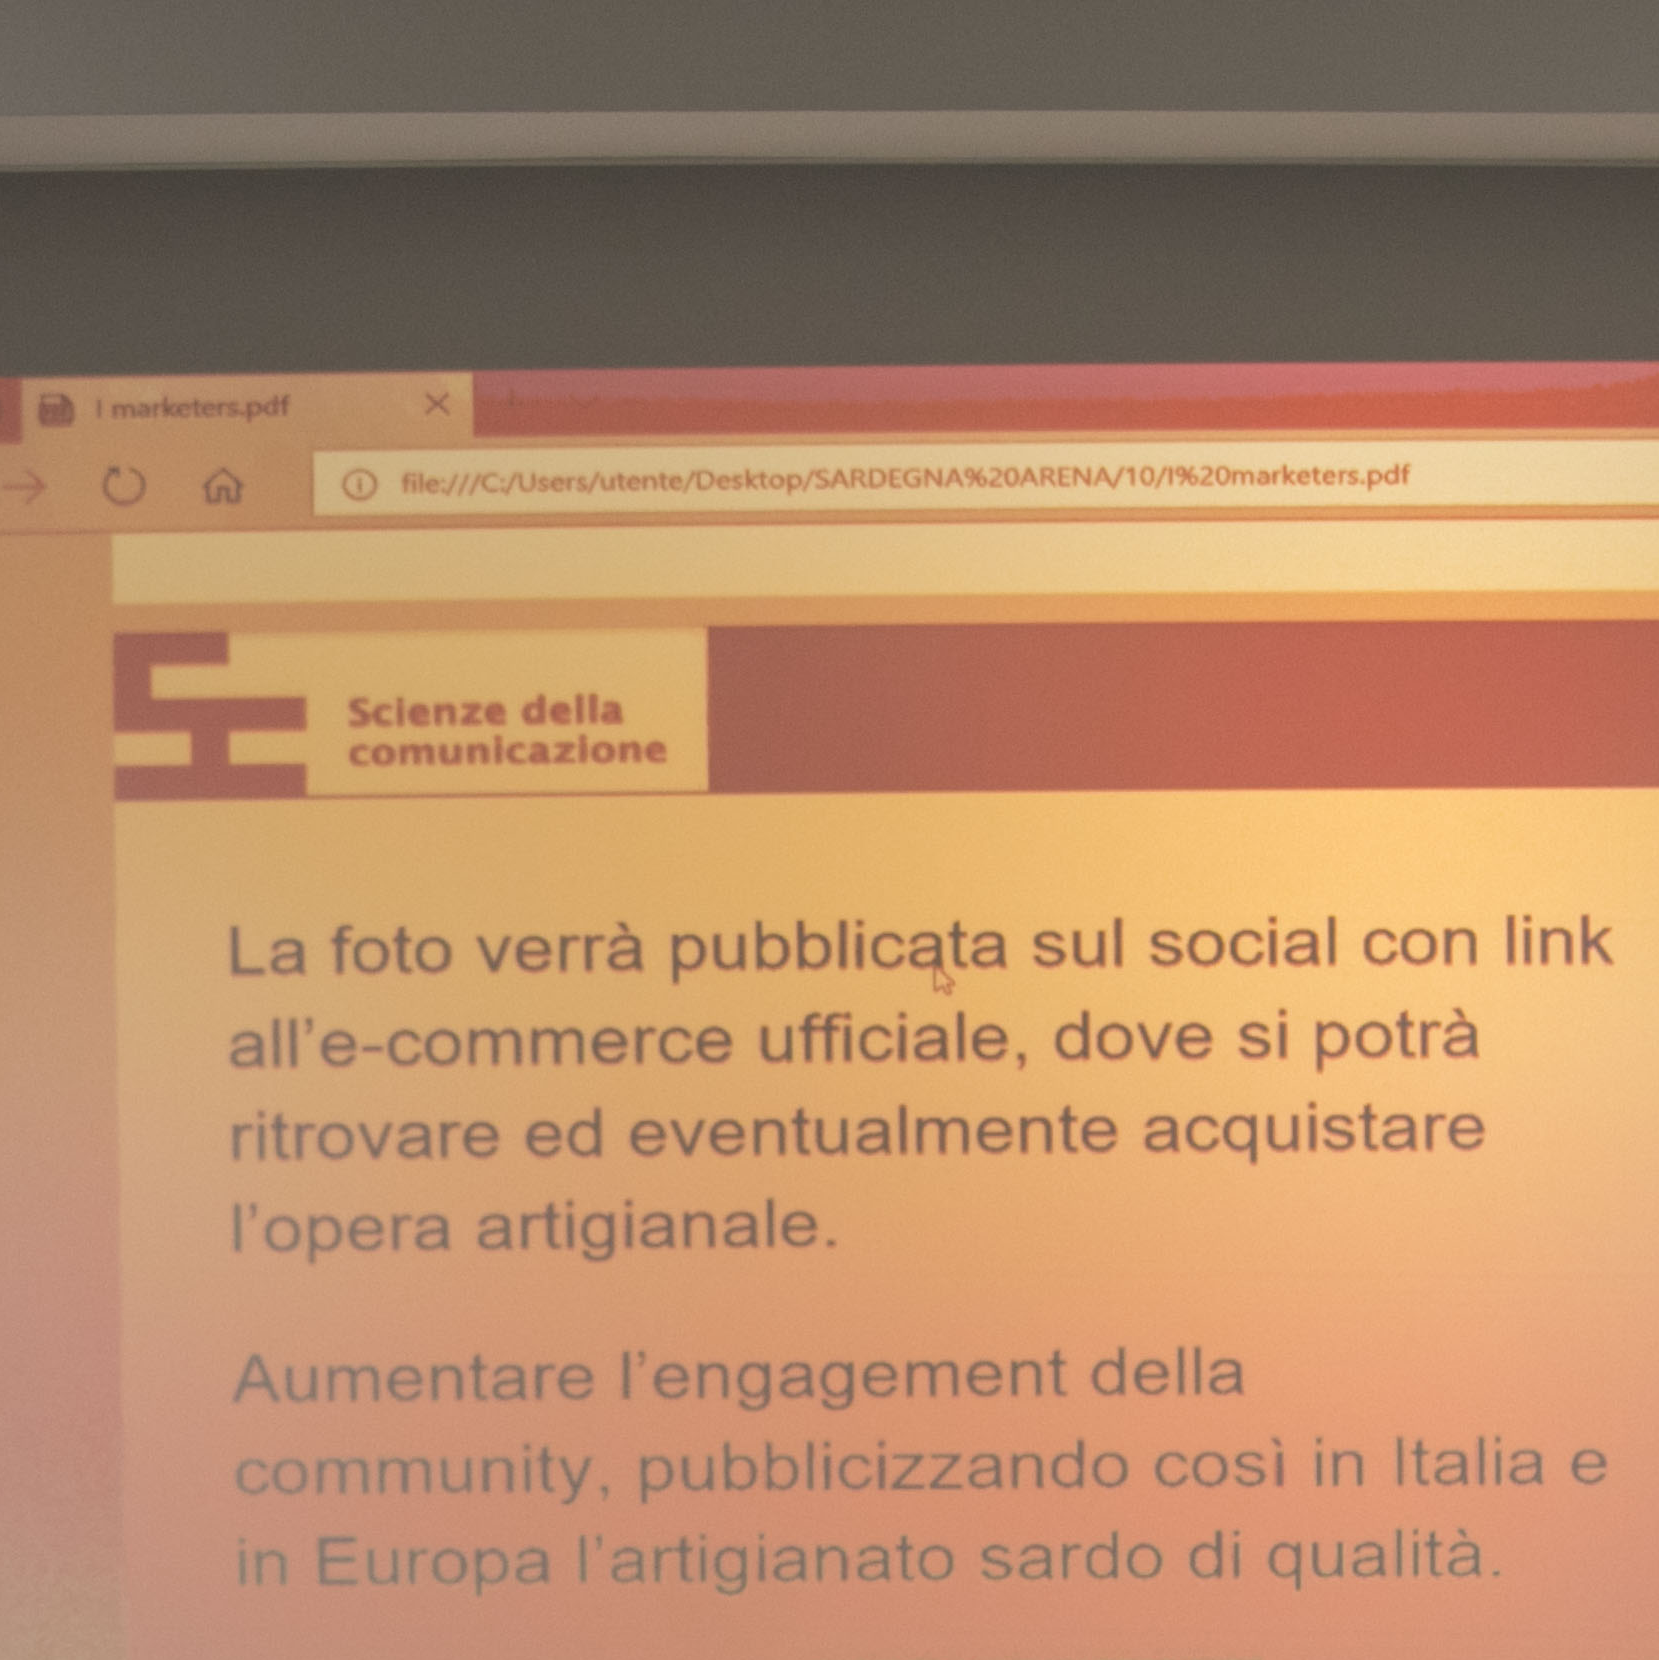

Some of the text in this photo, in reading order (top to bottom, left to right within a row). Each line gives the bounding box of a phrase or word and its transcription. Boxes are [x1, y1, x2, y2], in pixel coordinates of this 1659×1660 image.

[111, 394, 290, 424] marketers.pdf
[348, 693, 624, 728] Scienze della
[348, 733, 668, 769] comunicazione
[230, 914, 1615, 984] La foto verrà pubblicata sul social con link
[758, 1010, 1029, 1070] ufficiale,
[1054, 1009, 1212, 1062] dove
[1238, 1009, 1289, 1061] si
[1315, 1008, 1480, 1074] potrà
[230, 1102, 1487, 1167] ritrovare ed eventualmente acquistare
[476, 1198, 838, 1263] artigianale.
[232, 1353, 595, 1403] Aumentare
[1090, 1346, 1245, 1398] della
[234, 1436, 1609, 1506] community, pubblicizzando così in Italia e
[237, 1537, 288, 1588] in
[317, 1536, 551, 1596] Europa
[980, 1531, 1163, 1582] sardo
[1188, 1530, 1243, 1580] di
[1267, 1528, 1503, 1592] qualità.
